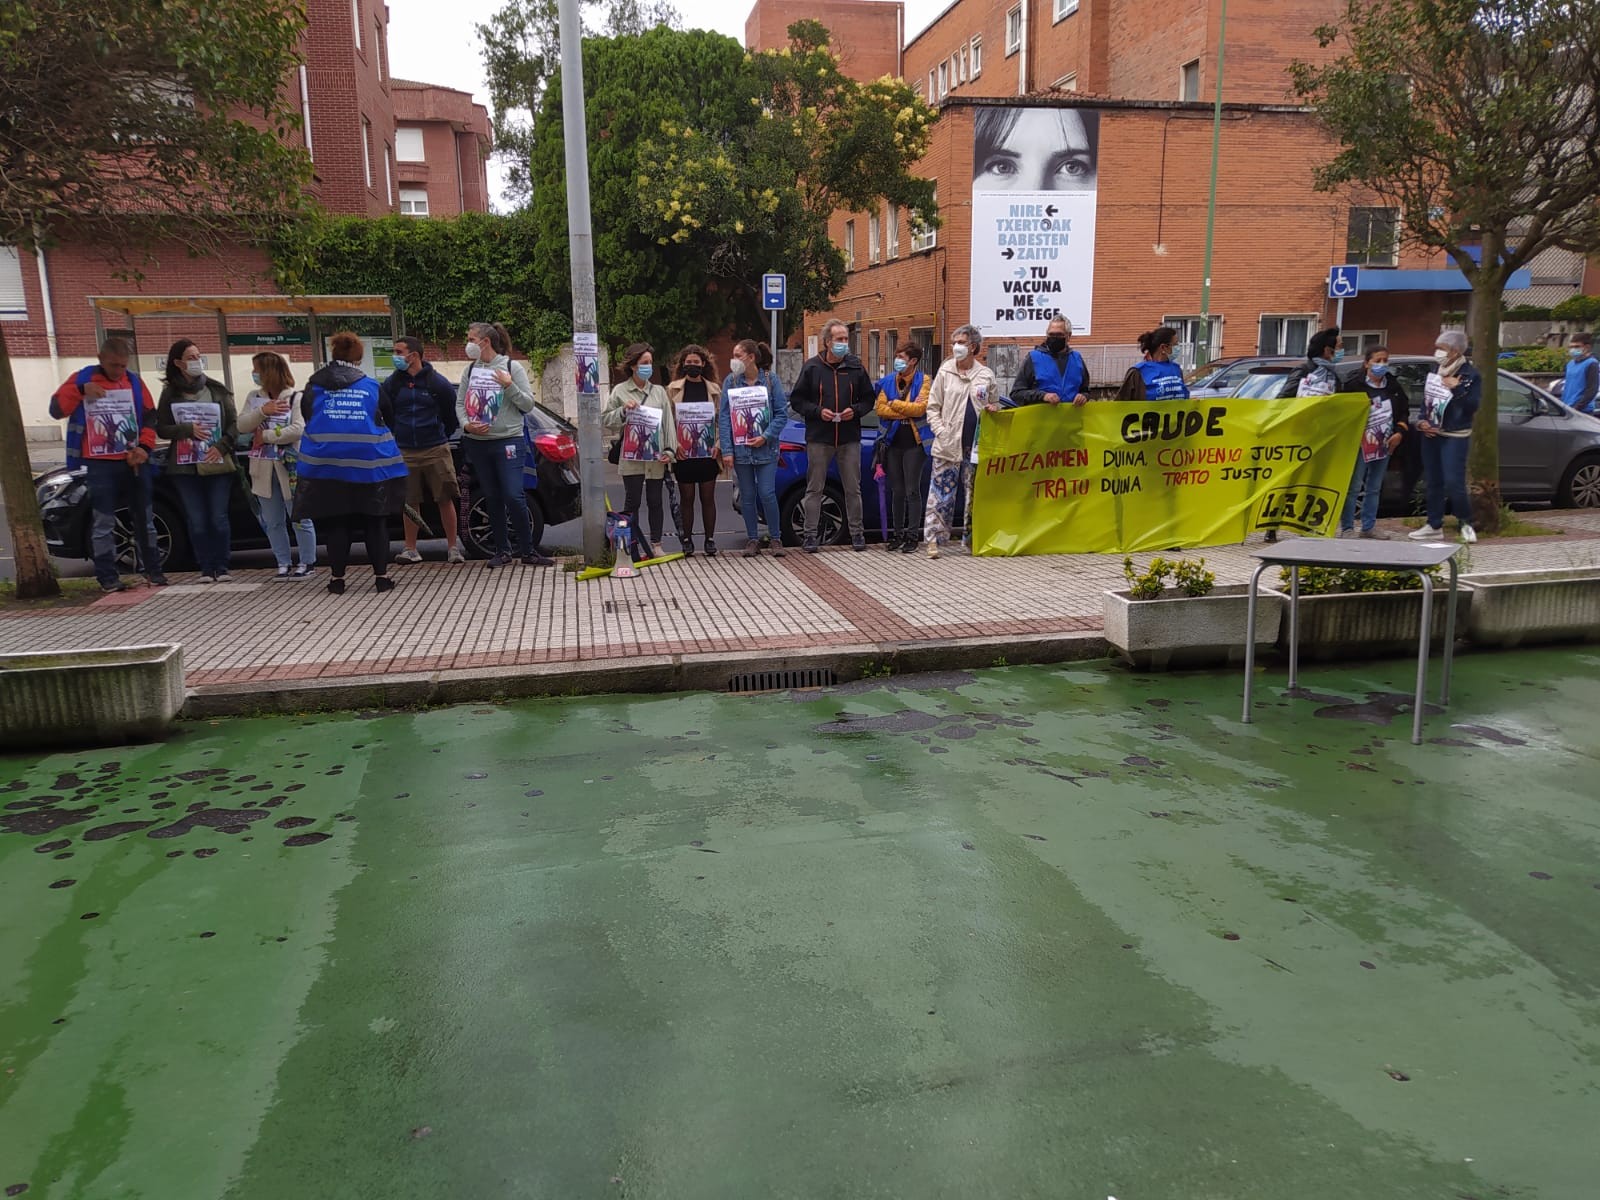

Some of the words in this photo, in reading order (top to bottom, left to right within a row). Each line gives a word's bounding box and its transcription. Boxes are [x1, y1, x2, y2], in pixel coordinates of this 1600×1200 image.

[1009, 204, 1043, 217] NIRE
[995, 218, 1072, 232] TXERTOAK
[998, 233, 1069, 246] BABESTEN
[1017, 247, 1059, 260] ZAITU
[1030, 266, 1048, 279] TU
[1003, 281, 1062, 293] VACUNA
[1013, 295, 1034, 307] ME
[1121, 407, 1226, 444] GAUDE
[986, 448, 1089, 476] HITZARMEN
[1157, 447, 1243, 468] CONVENIO
[1250, 444, 1313, 463] JUSTO
[1031, 477, 1090, 499] TRATU
[1101, 476, 1142, 496] DUINA
[1162, 470, 1211, 487] TRATO
[1220, 467, 1273, 481] JUSTO
[1261, 493, 1330, 527] LAB
